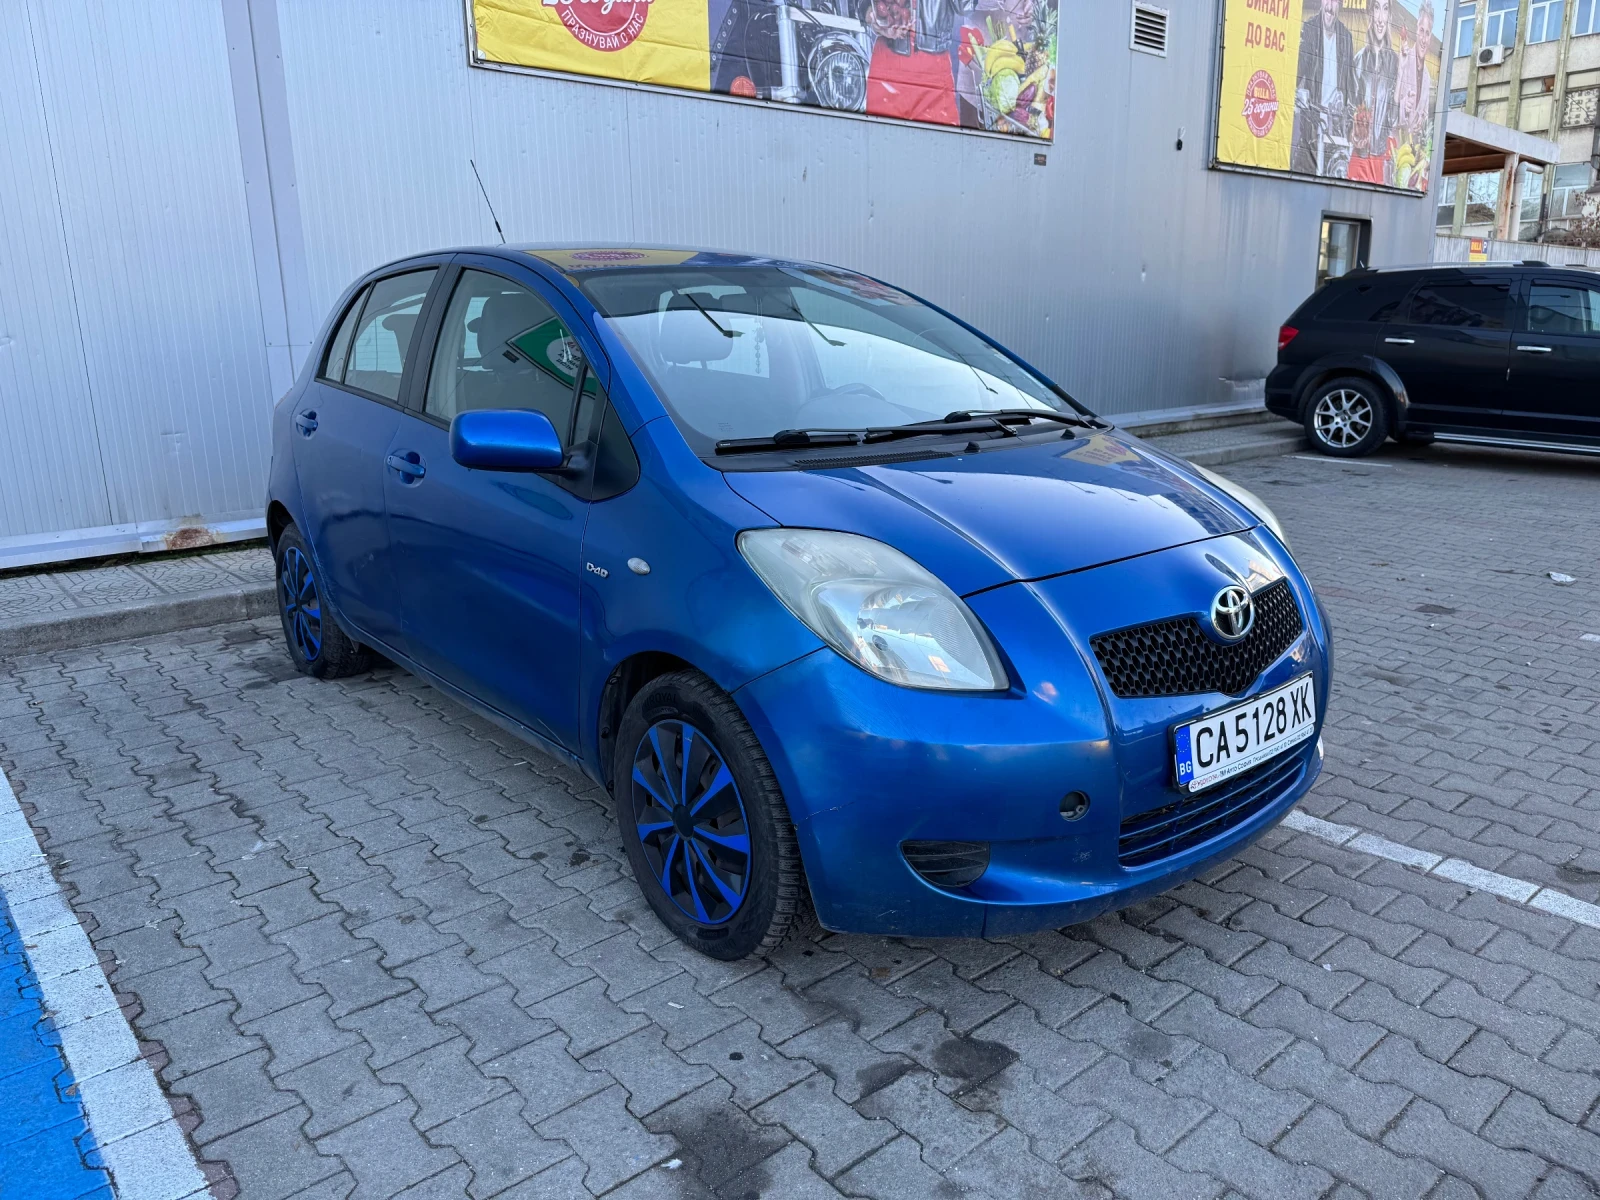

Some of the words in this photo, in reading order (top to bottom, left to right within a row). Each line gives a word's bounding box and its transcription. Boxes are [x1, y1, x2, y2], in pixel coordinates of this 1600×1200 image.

[561, 10, 620, 49] ПРАЗНУВАЙ
[620, 32, 628, 44] С
[628, 13, 644, 38] НАС
[1245, 22, 1262, 49] ДО
[1264, 27, 1286, 52] ВАС
[1241, 98, 1256, 115] 25
[586, 562, 609, 578] D-4D
[1196, 720, 1231, 768] CA
[1235, 696, 1287, 753] 5128
[1290, 682, 1312, 729] XK
[1179, 761, 1192, 776] BG
